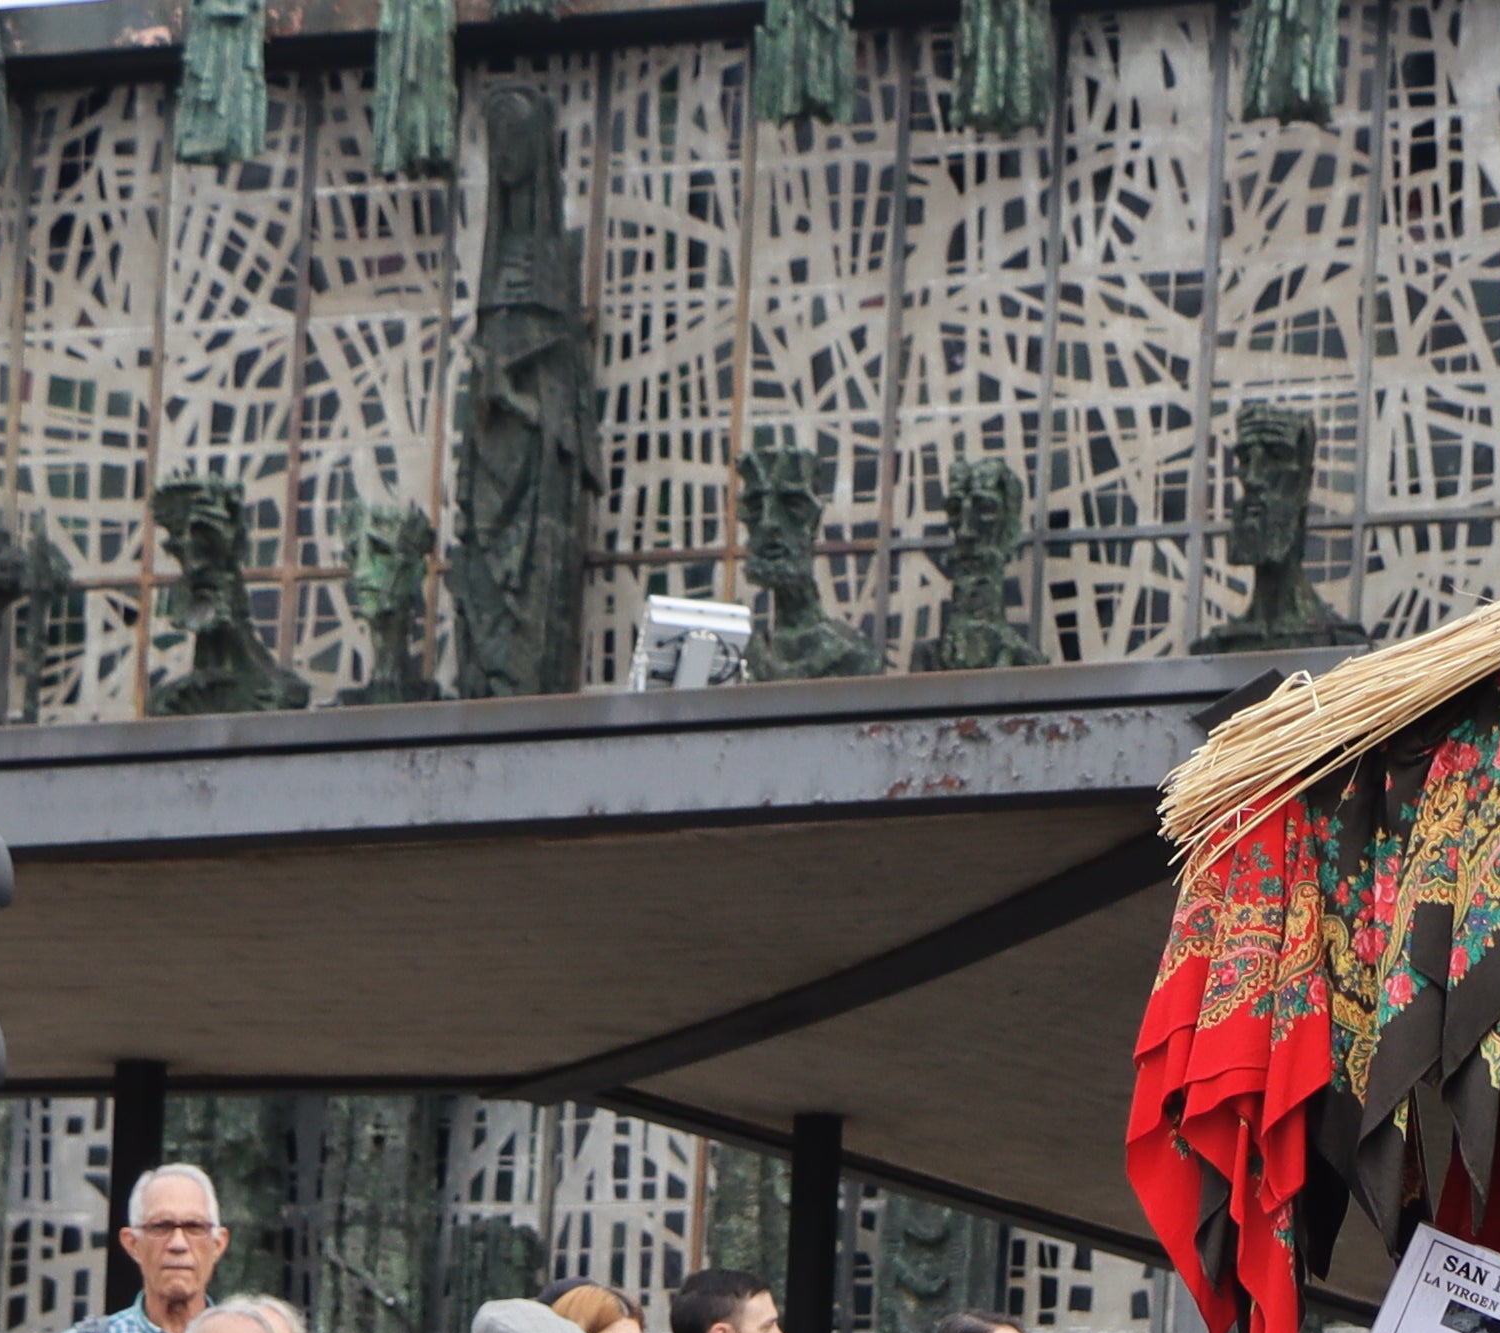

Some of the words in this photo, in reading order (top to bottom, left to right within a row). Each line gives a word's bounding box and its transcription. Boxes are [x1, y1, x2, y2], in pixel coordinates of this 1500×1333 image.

[1443, 1254, 1490, 1286] SAN
[1422, 1271, 1441, 1288] LA
[1446, 1280, 1500, 1312] VIRGEN
